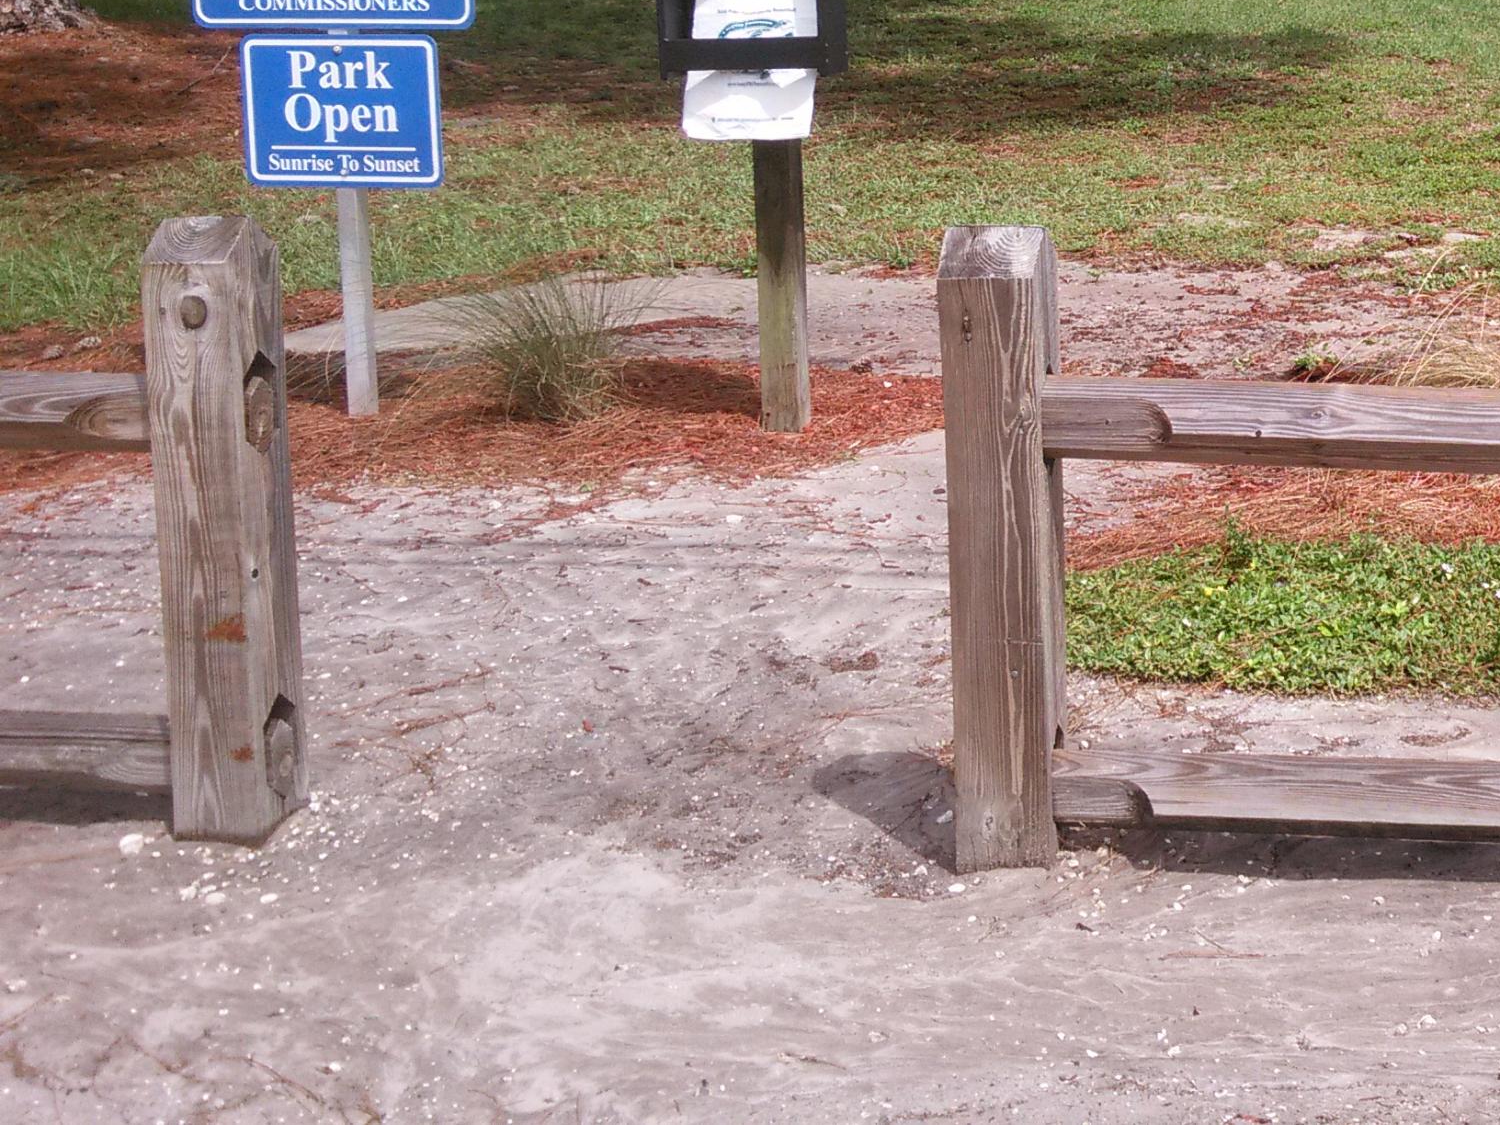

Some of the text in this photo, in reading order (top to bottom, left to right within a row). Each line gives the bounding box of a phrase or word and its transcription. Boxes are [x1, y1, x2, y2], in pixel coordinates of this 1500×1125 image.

[286, 50, 394, 90] Park
[284, 92, 399, 143] Open
[268, 153, 421, 173] Sunrise To Sunset
